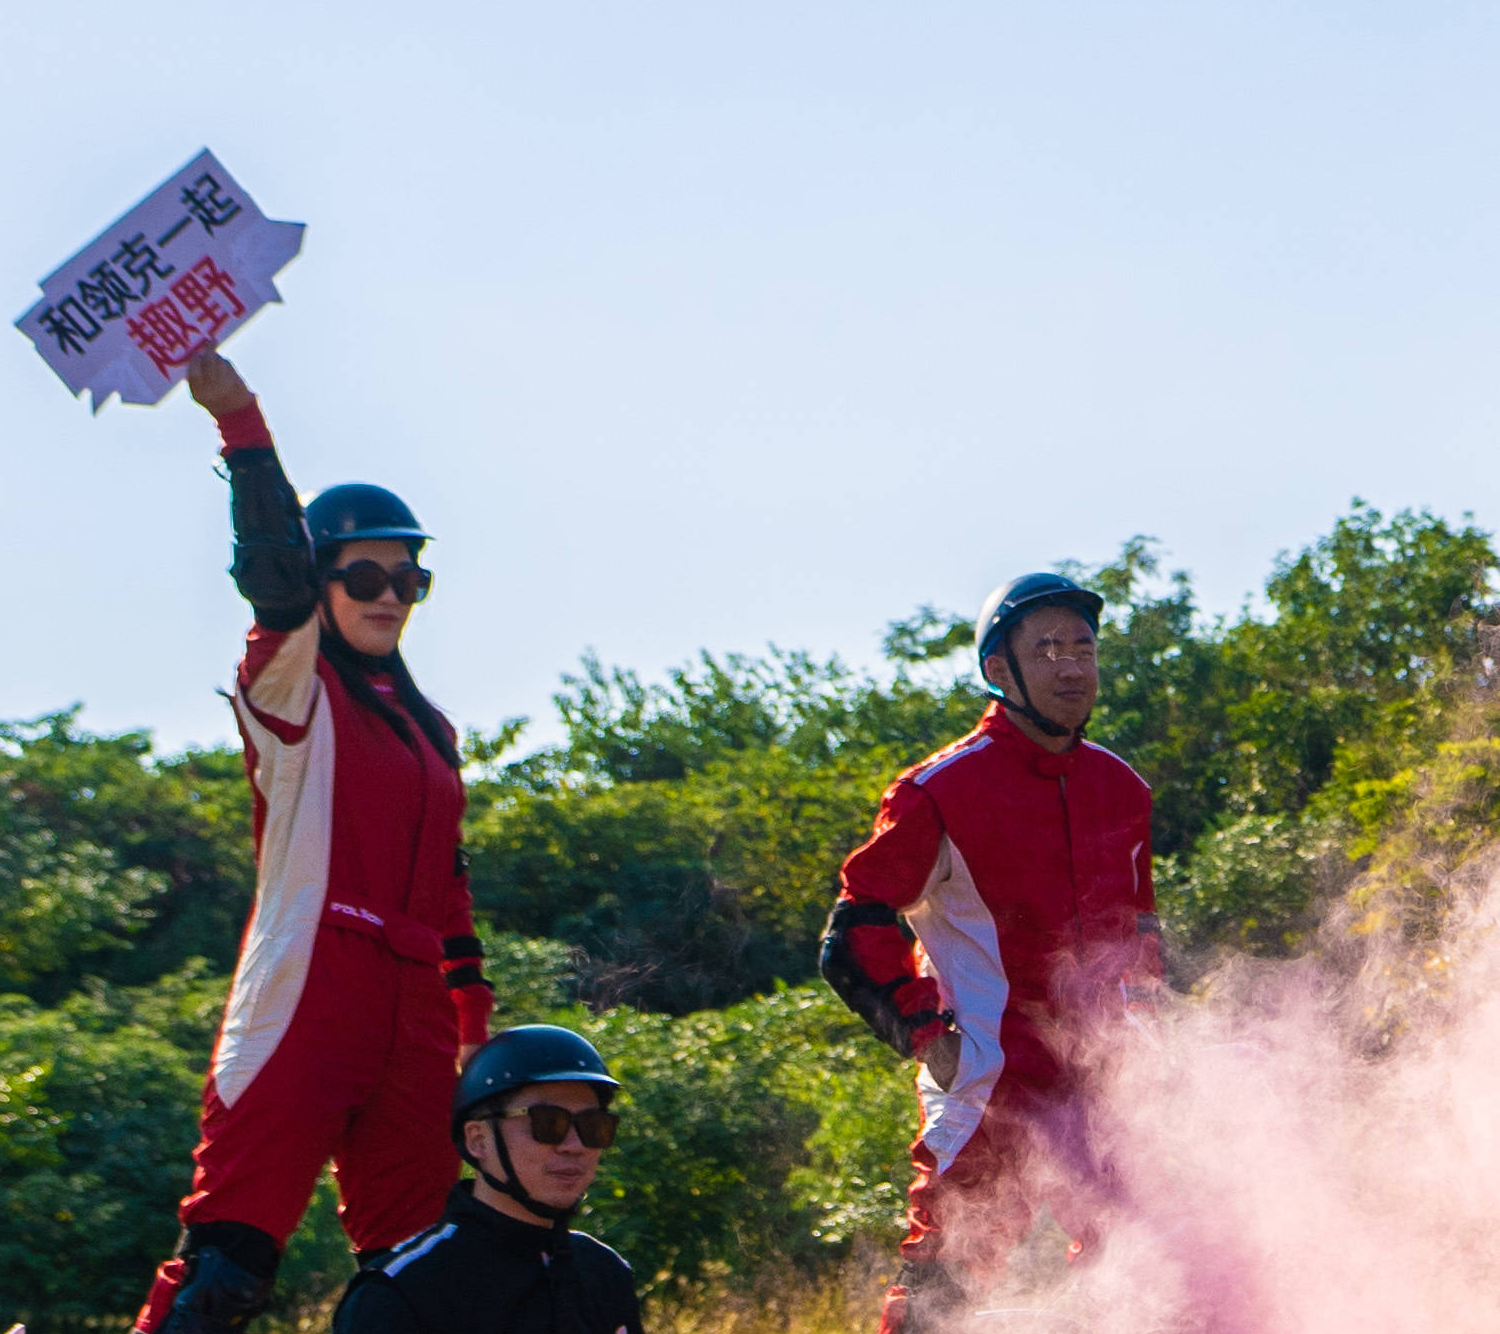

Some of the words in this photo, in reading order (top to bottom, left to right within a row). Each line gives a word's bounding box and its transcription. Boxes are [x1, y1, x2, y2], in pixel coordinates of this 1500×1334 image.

[37, 172, 243, 357] 和领克一起
[125, 254, 247, 381] 趣野
